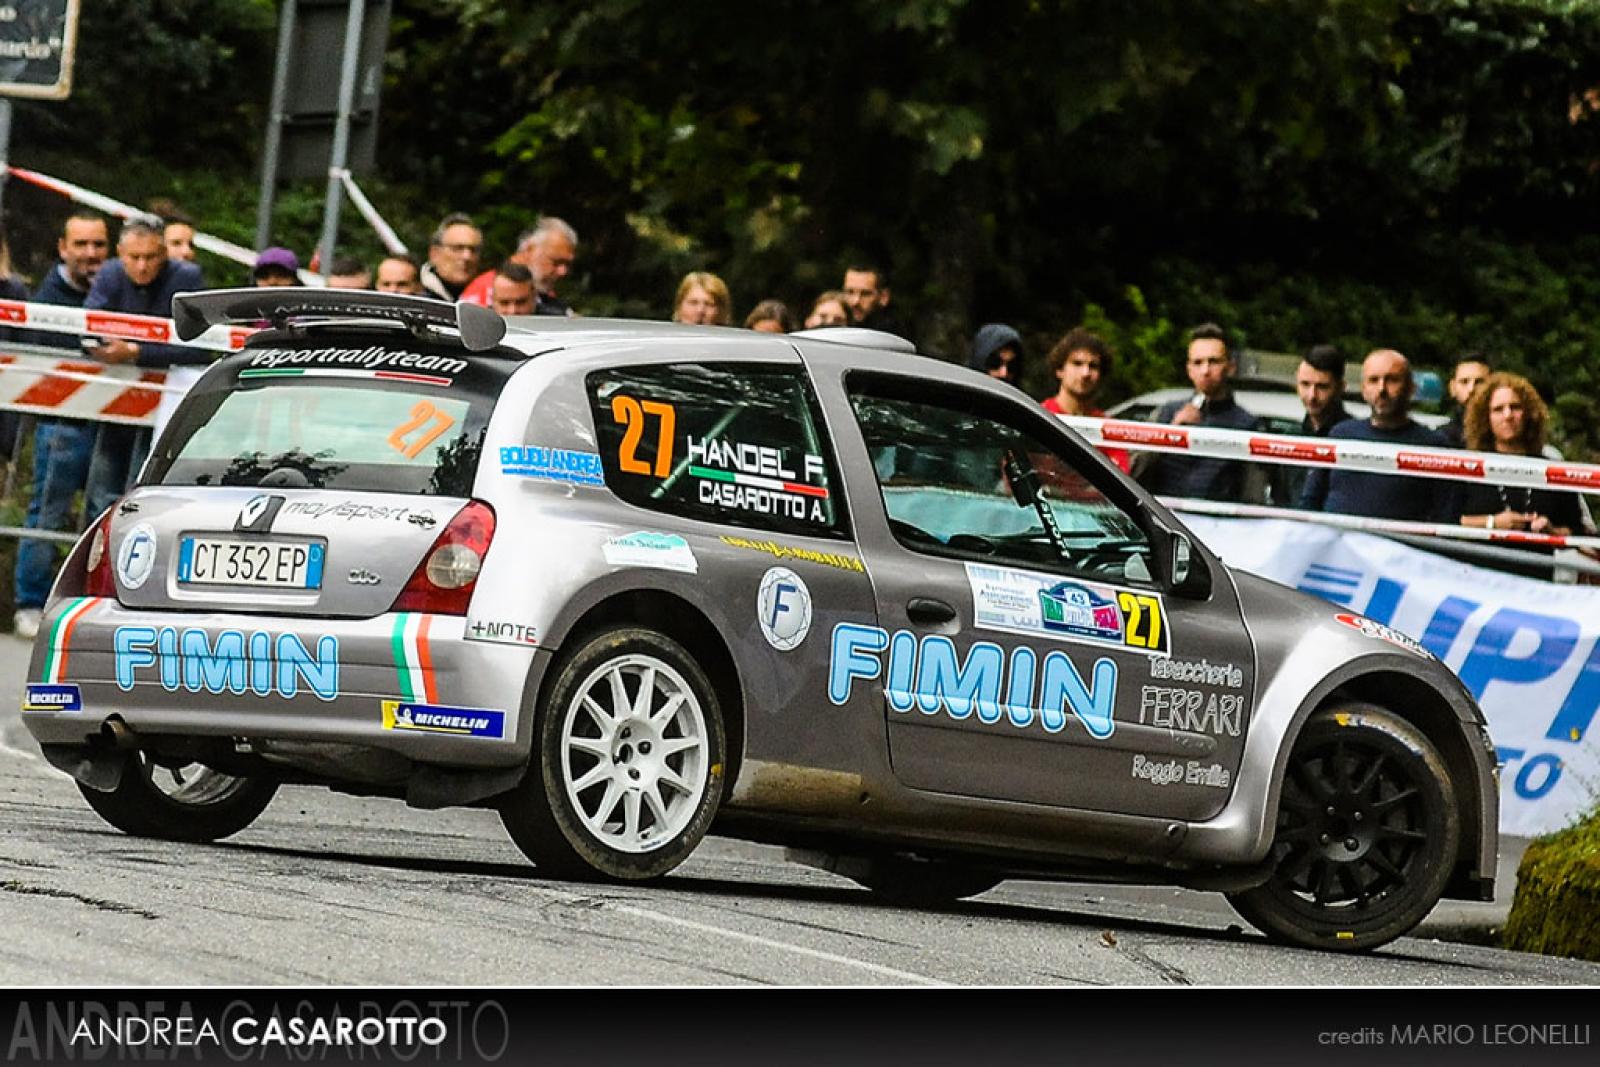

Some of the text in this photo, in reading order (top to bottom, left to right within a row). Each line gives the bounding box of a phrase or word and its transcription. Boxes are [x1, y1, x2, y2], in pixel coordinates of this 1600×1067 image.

[387, 400, 454, 459] 27
[606, 394, 675, 478] 27
[687, 436, 796, 480] HANDEL
[699, 481, 805, 518] CASAROTTO
[194, 544, 306, 582] CT 352 EP
[1119, 592, 1162, 648] 27
[114, 625, 339, 701] FIMIN
[827, 622, 1118, 739] FIMIN
[415, 712, 490, 729] MICHELIN
[1139, 685, 1244, 737] FERRARI
